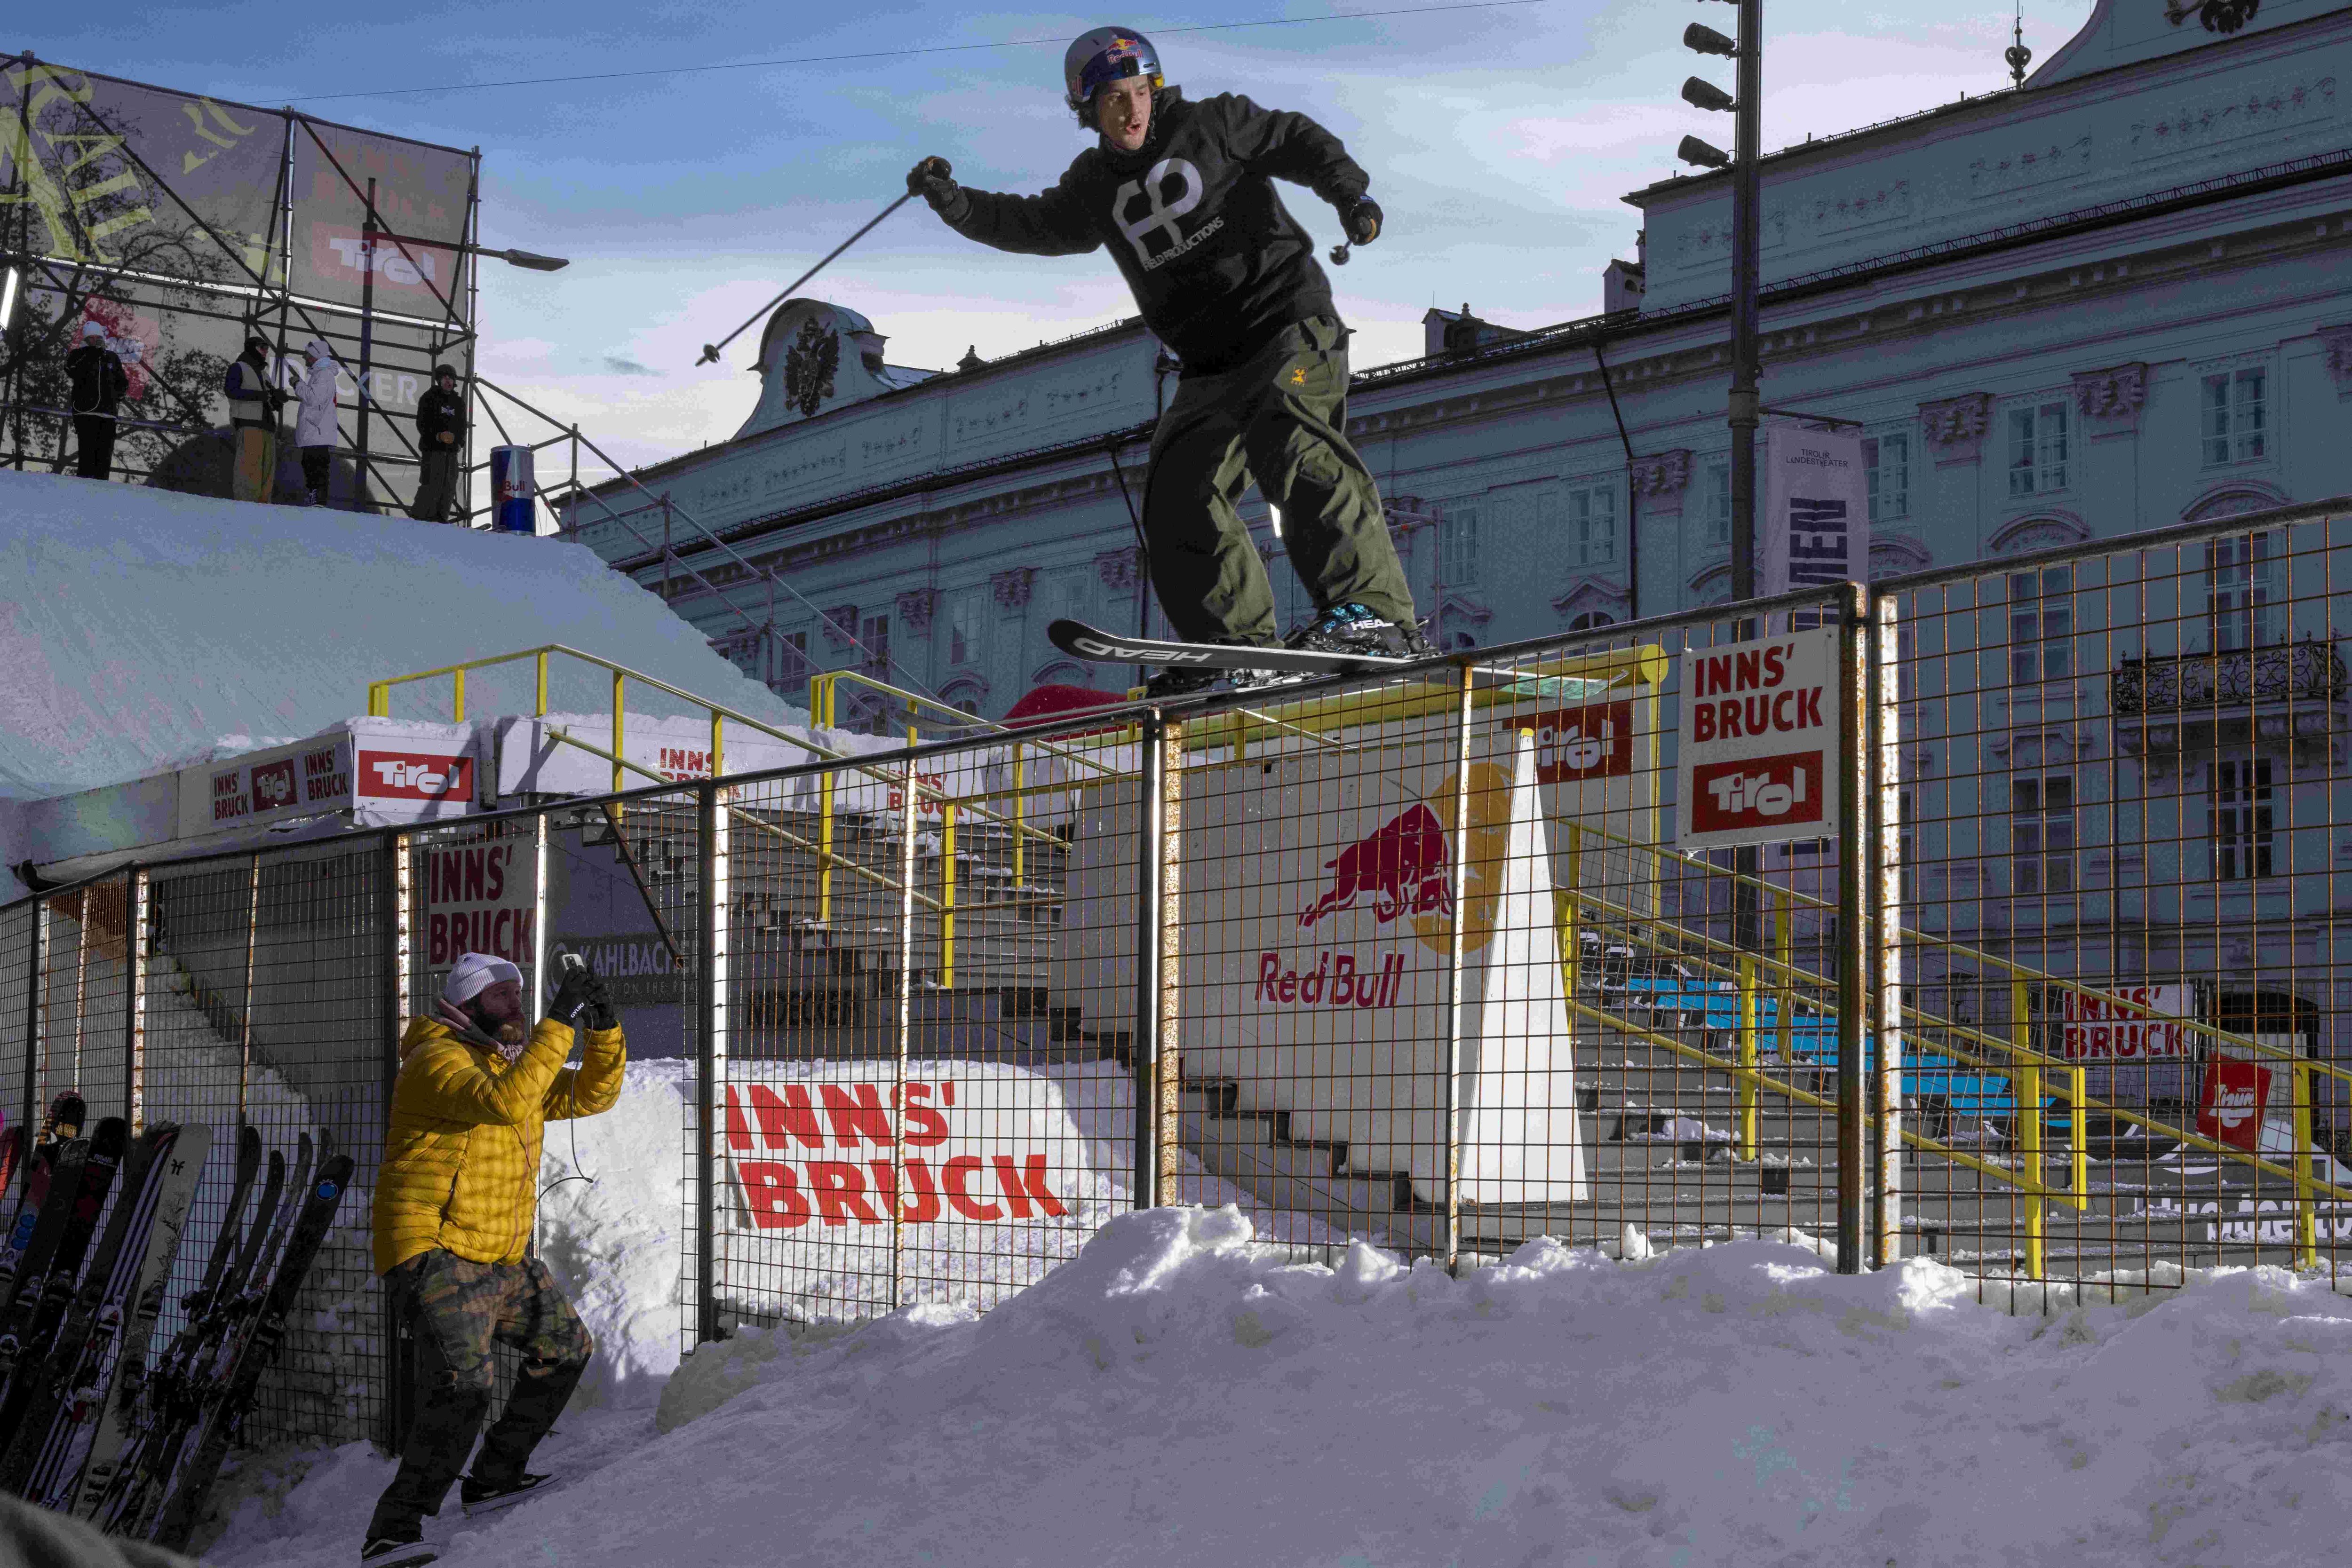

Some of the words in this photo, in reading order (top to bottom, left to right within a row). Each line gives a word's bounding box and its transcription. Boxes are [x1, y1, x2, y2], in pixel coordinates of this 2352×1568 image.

[1107, 50, 1128, 65] Red
[1162, 216, 1224, 261] PRODUCTIONS
[330, 238, 436, 285] Tirol
[1786, 455, 1848, 467] LANDESTHEATER
[1801, 449, 1830, 459] TIROLER
[504, 481, 525, 491] Bull
[1351, 619, 1395, 631] HEA
[1073, 637, 1213, 662] HEAD
[1695, 642, 1794, 697] INNS'
[1694, 686, 1823, 743] BRUCK
[1536, 718, 1614, 769] irol
[305, 746, 335, 776] INNS'
[373, 760, 459, 793] Tirol
[214, 771, 240, 797] INNS'
[256, 769, 291, 800] Tirol
[307, 772, 349, 800] BRUCK
[1708, 766, 1806, 816] Tirol
[215, 792, 249, 820] BRUCK
[431, 844, 513, 903] INNS'
[430, 908, 535, 965] BRUCK
[1255, 951, 1329, 1004] Red
[1329, 953, 1405, 1007] Bull
[571, 1002, 585, 1018] OYUKI
[2065, 1023, 2190, 1058] BRUCK
[727, 1081, 955, 1150] INNS'
[737, 1154, 1070, 1229] BRUCK
